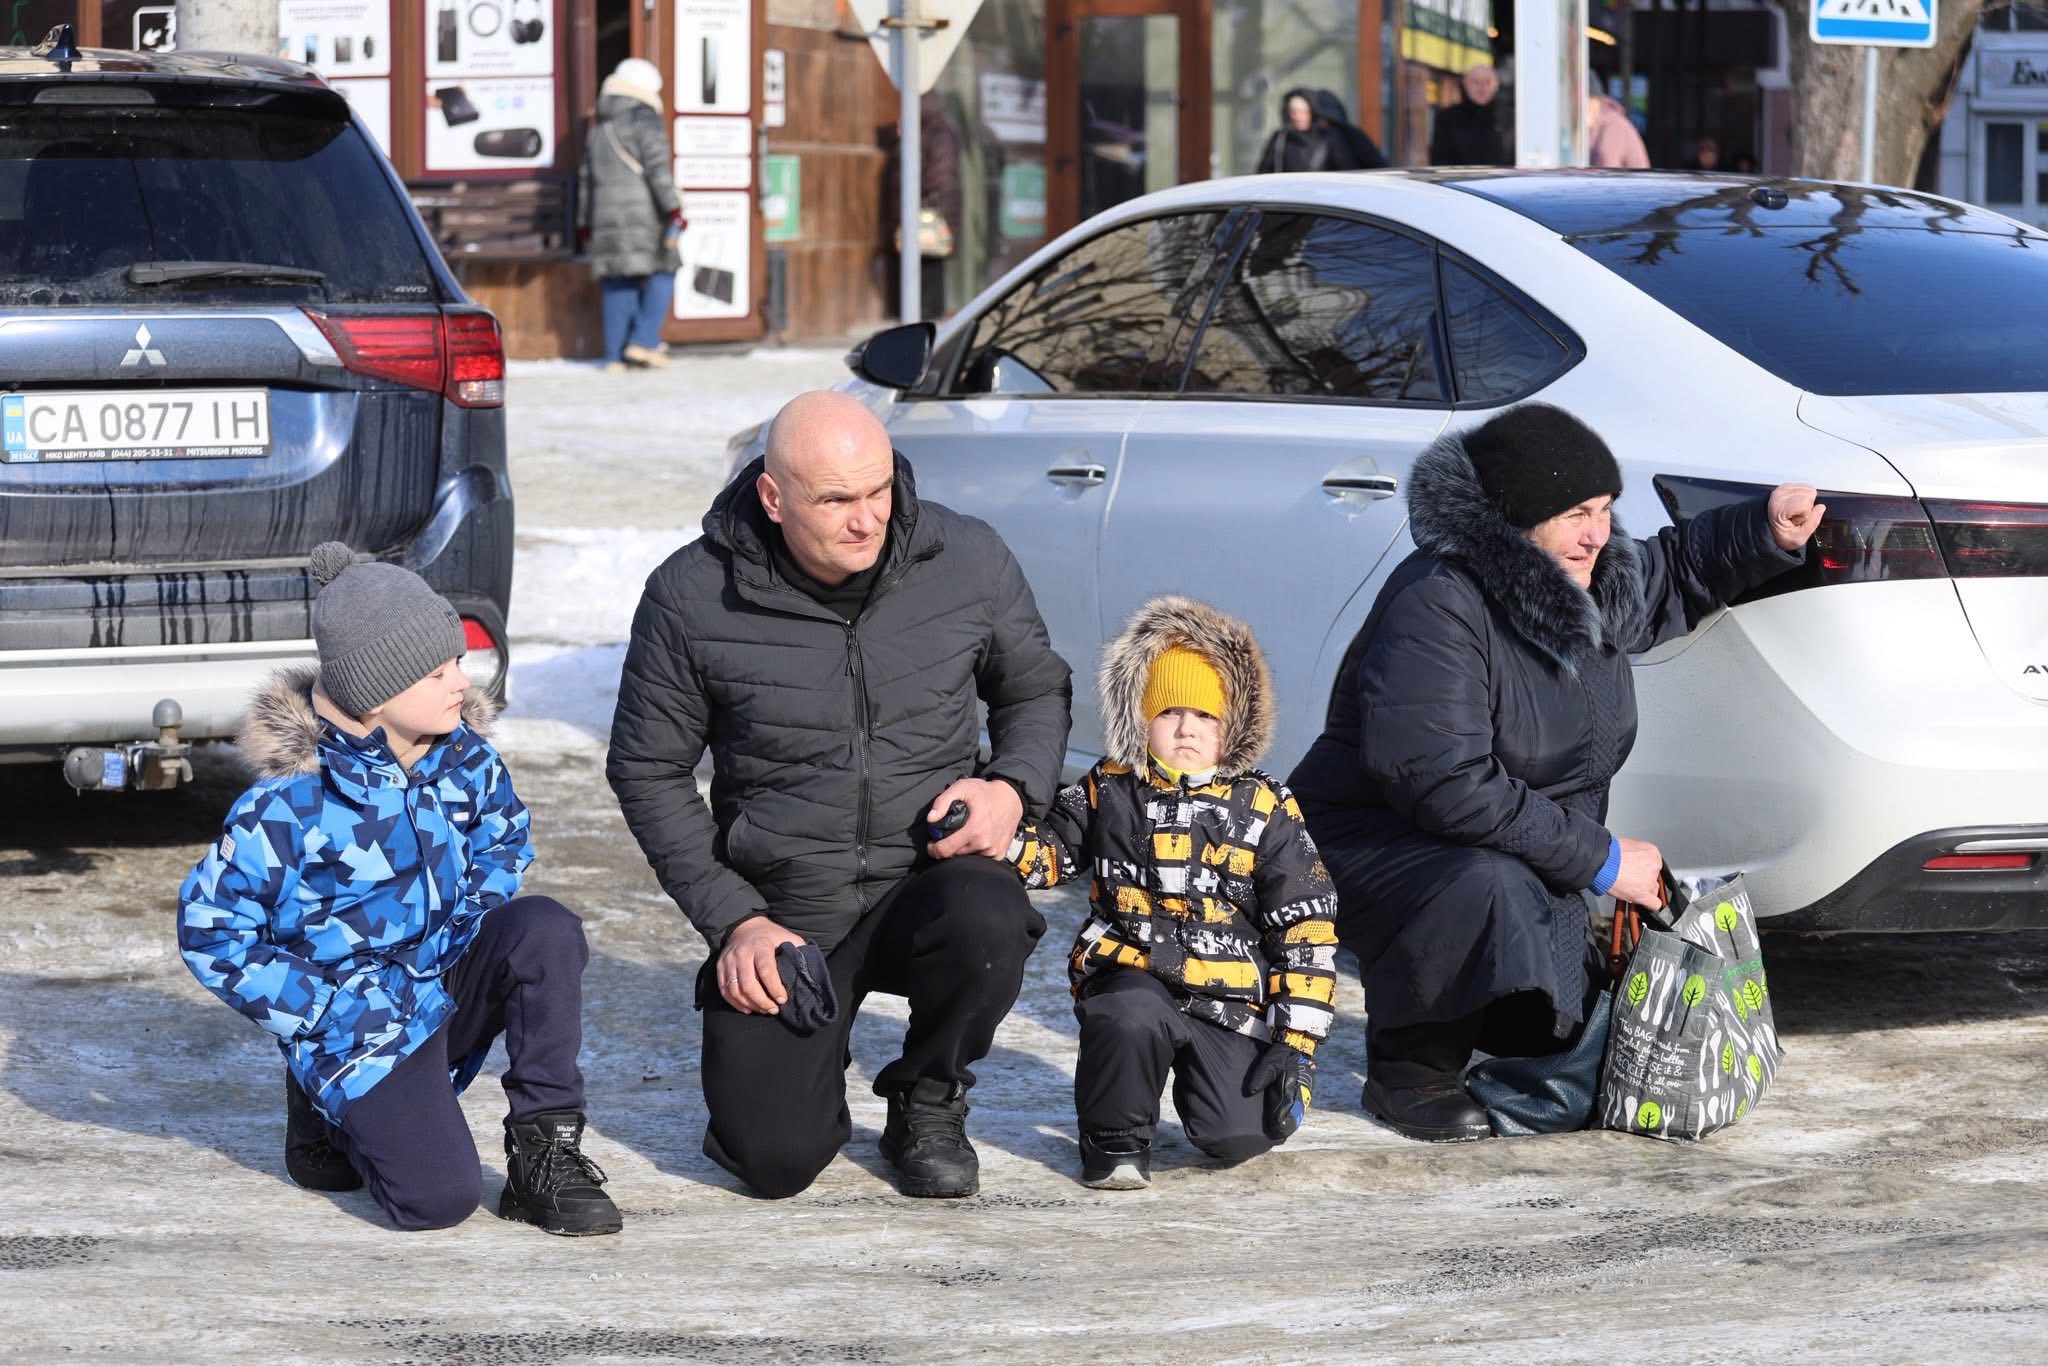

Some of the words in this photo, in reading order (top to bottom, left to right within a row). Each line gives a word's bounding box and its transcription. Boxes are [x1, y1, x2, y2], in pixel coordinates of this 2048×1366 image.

[100, 401, 193, 442] 0877
[7, 431, 24, 444] UA
[64, 451, 88, 460] ЦЕНТР
[111, 449, 131, 459] (044)
[132, 448, 173, 458] 205-33-31
[186, 446, 229, 457] MITSUBISHI
[231, 446, 263, 456] MOTORS
[1619, 1017, 1633, 1036] This
[1634, 1025, 1654, 1042] BAG
[1671, 1043, 1690, 1055] from
[1673, 1065, 1683, 1077] &
[1648, 1085, 1667, 1096] YOU.
